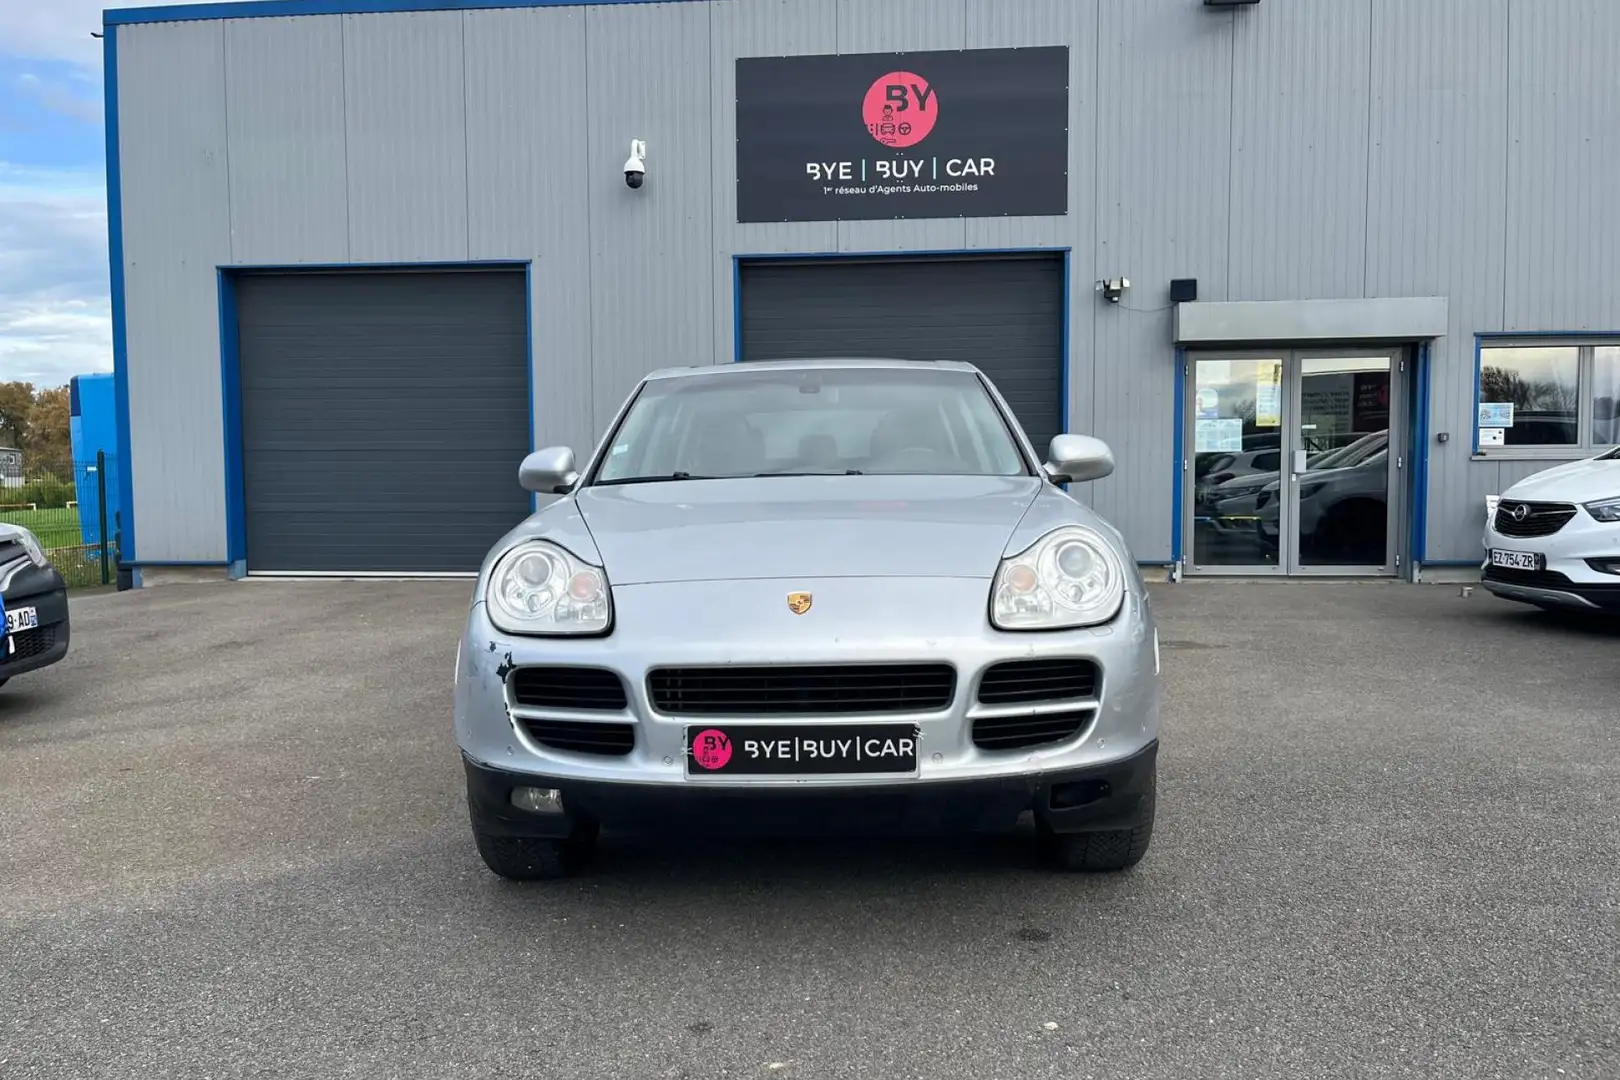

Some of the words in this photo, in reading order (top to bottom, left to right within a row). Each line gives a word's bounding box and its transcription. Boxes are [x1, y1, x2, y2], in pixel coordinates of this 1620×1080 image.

[886, 84, 934, 112] BY
[806, 162, 852, 180] BYE
[875, 160, 924, 178] BUY
[945, 158, 995, 176] CAR
[834, 186, 867, 195] réseau
[868, 183, 912, 195] d'Agents
[913, 182, 979, 193] Auto-mobiles
[704, 735, 729, 751] BY
